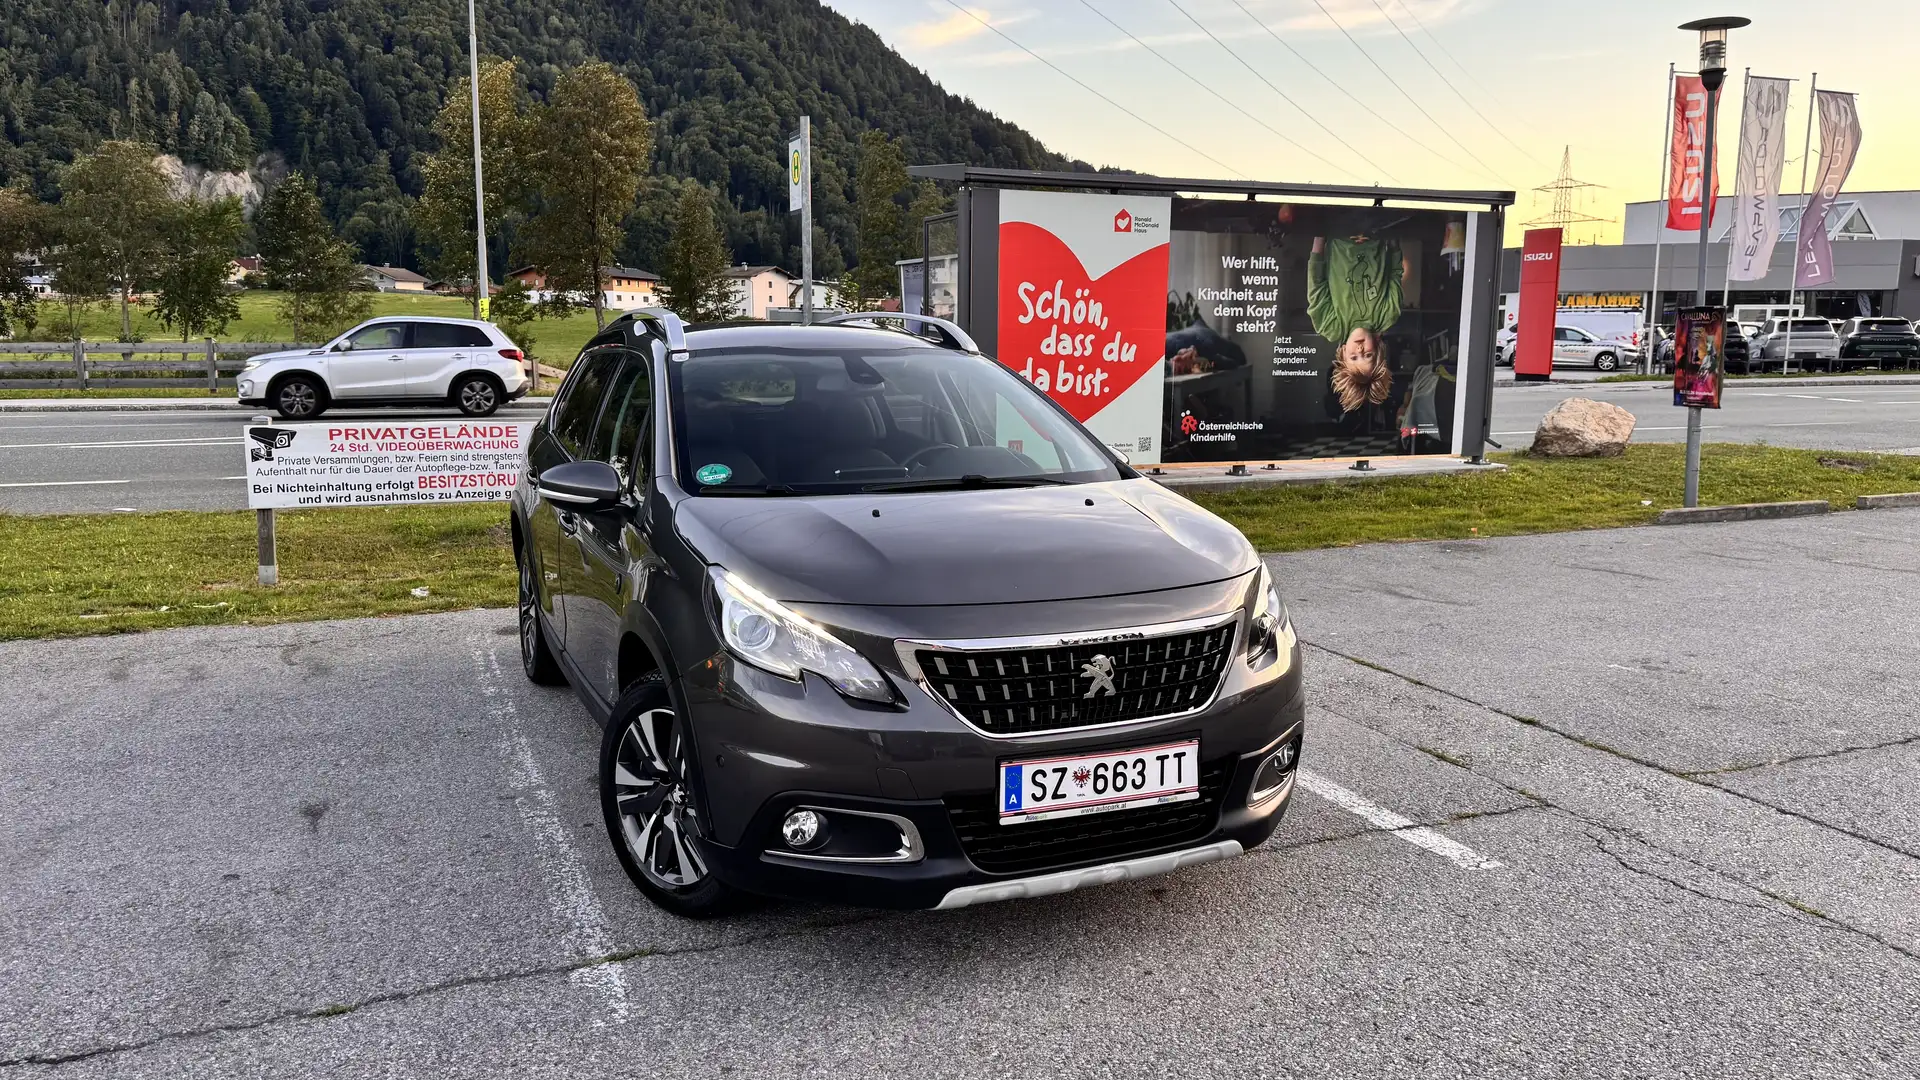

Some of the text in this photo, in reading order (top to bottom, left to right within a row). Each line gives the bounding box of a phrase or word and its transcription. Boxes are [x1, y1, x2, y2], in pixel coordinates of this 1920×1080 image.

[1681, 92, 1705, 215] ISUZU
[1523, 252, 1553, 261] ISUZU
[1222, 256, 1279, 273] Wer hilft,
[1242, 274, 1278, 286] wenn
[1197, 287, 1278, 302] Kindheit auf
[1566, 295, 1641, 307] ANNAHME
[1018, 279, 1109, 330] Schön,
[1213, 304, 1277, 320] dem Kopf
[1236, 320, 1276, 333] steht?
[1040, 324, 1137, 363] dass du
[1274, 336, 1292, 344] Jetzt
[1273, 346, 1317, 355] Perspektive
[1273, 356, 1308, 365] spenden:
[1018, 357, 1110, 396] da bist.
[328, 424, 518, 441] PRIVATGELÄNDE
[1198, 420, 1263, 431] Österreichische
[1190, 432, 1236, 442] Kinderhilfe
[330, 439, 519, 453] 24 Std. VIDEOÜBERWACHUNG
[277, 451, 522, 466] Private Versammlungen, bzw. Feiern sind strengstens
[255, 462, 520, 477] Aufenthalt nur für die Dauer der Autopflege-bzw. Tankv
[253, 472, 517, 494] Bei Nichteinhaltung erfolgt BESITZSTÖRU
[298, 495, 321, 505] und
[325, 493, 351, 503] wird
[355, 491, 434, 502] ausnahmslos
[455, 489, 502, 500] Anzeige
[1031, 752, 1187, 803] SZ 663 TT
[1009, 794, 1018, 804] A
